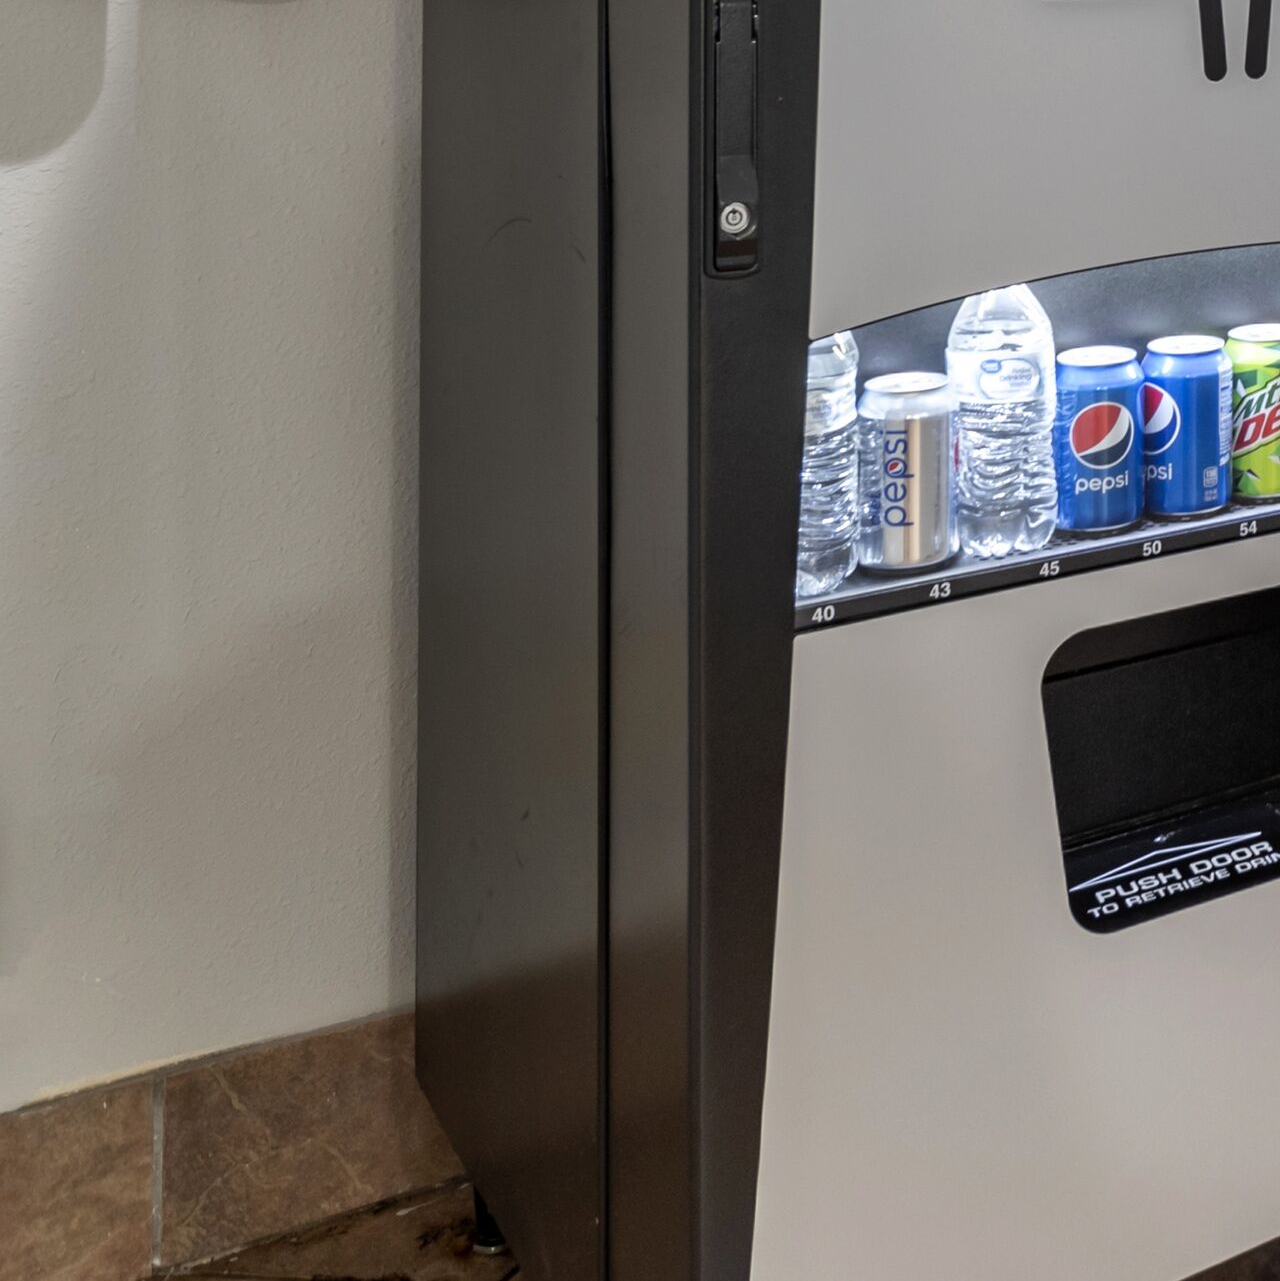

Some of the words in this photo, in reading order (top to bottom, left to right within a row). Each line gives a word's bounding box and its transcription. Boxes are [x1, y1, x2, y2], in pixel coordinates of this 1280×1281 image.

[879, 429, 915, 527] pepsi
[1075, 470, 1130, 495] pepsi
[1143, 463, 1173, 484] psi
[1239, 519, 1258, 537] 54
[1142, 540, 1162, 557] 50
[1039, 561, 1060, 577] 45
[929, 582, 951, 600] 43
[812, 605, 835, 623] 40
[1094, 868, 1183, 904] PUSH
[1188, 840, 1274, 876] DOOR
[1087, 902, 1120, 919] TO
[1125, 867, 1231, 909] RETRIEVE
